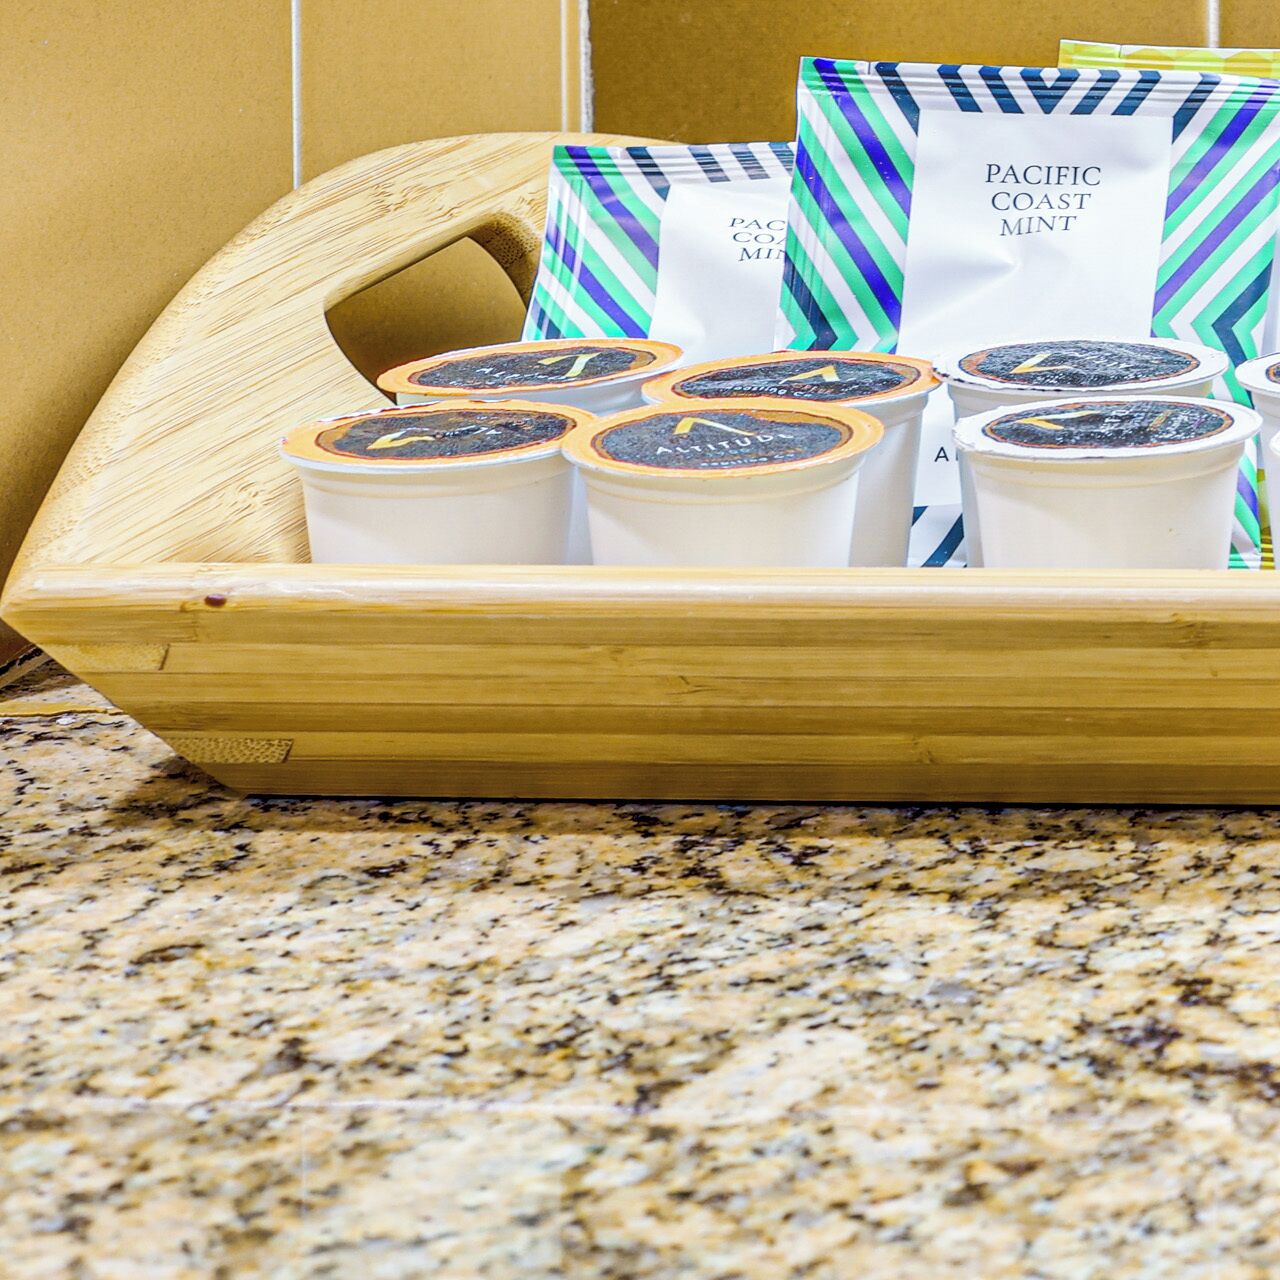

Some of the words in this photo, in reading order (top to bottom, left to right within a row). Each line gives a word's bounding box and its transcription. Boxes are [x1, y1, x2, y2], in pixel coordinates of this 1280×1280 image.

[985, 164, 1102, 186] PACIFIC
[991, 191, 1092, 211] COAST
[1000, 215, 1077, 237] MINT
